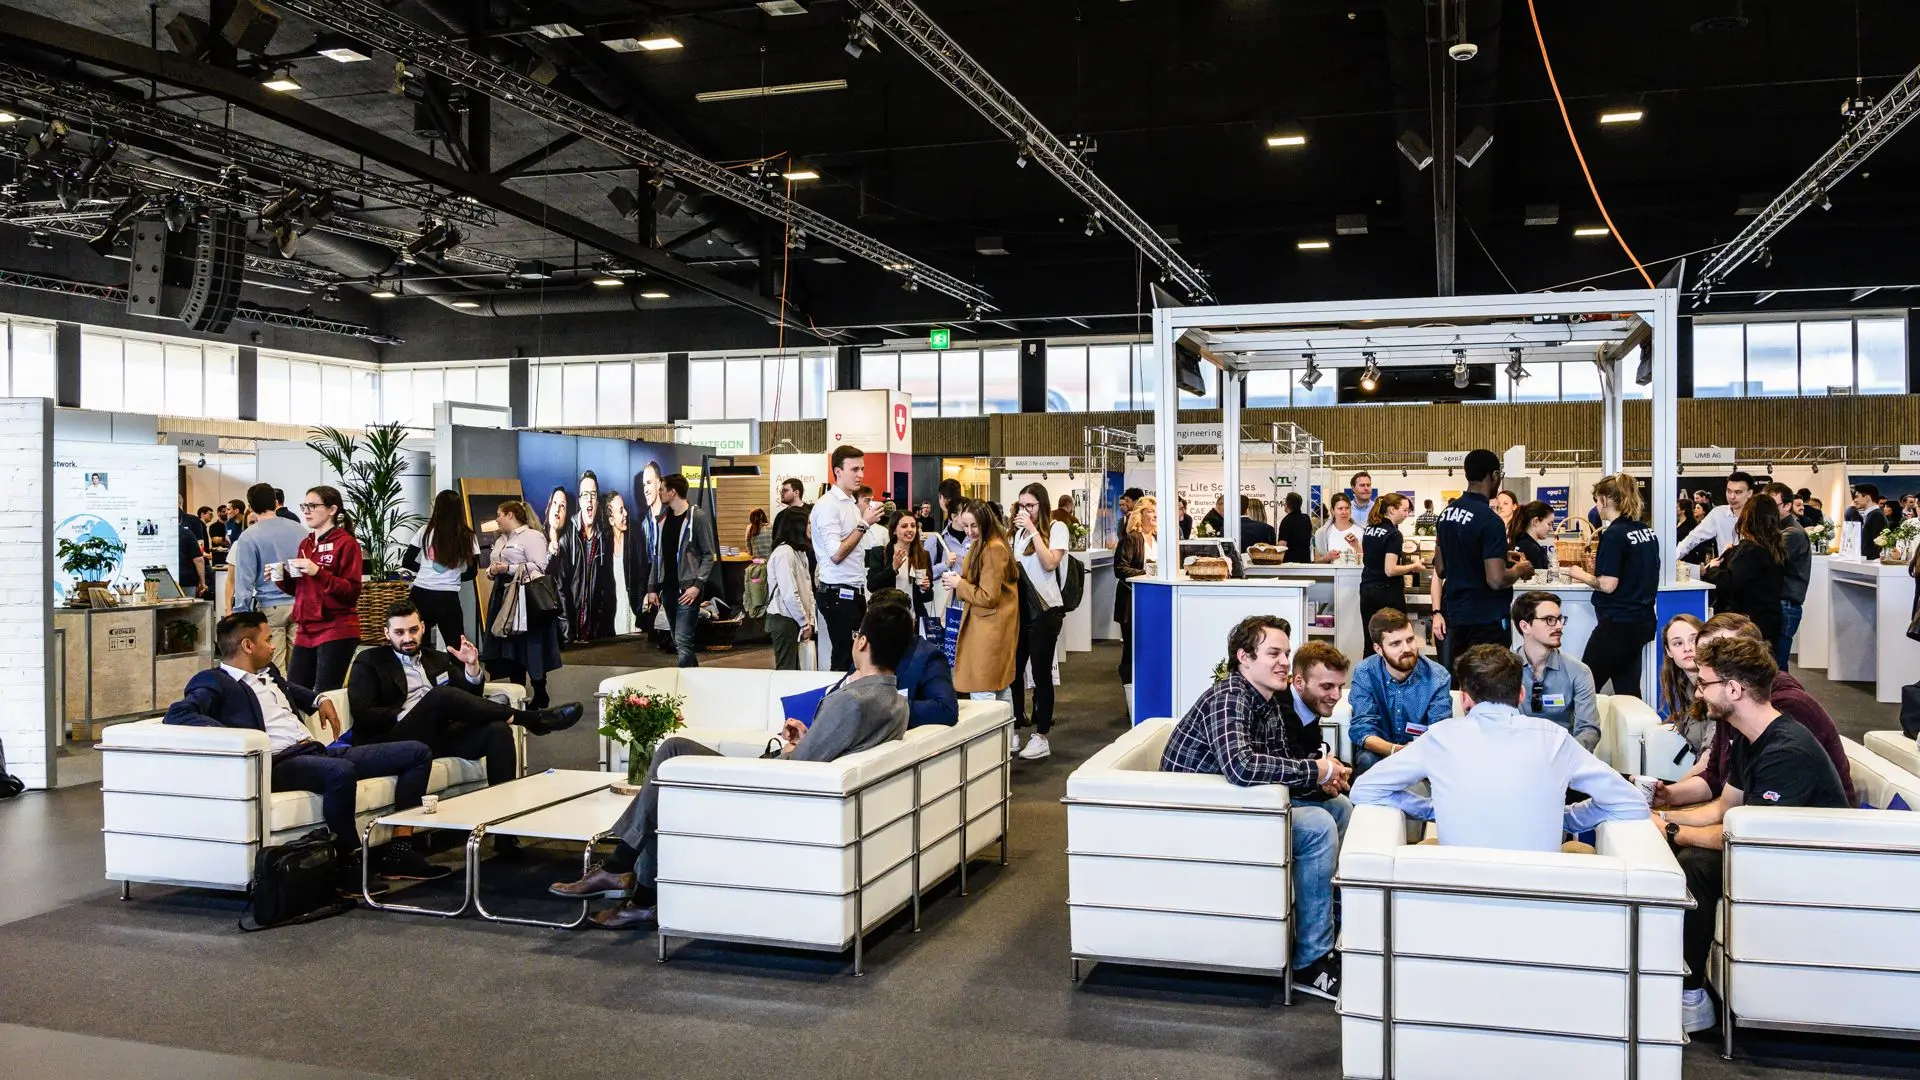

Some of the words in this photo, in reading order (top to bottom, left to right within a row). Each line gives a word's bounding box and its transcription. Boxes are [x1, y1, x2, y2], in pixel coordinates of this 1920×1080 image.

[1176, 429, 1222, 438] ngineering
[181, 439, 194, 447] IMT
[693, 440, 744, 449] YNTEGON
[52, 460, 78, 468] etwork.
[1190, 483, 1209, 492] Life
[1210, 483, 1256, 492] Scces
[1439, 506, 1475, 526] STAFF
[1364, 526, 1388, 538] TAFF
[1626, 527, 1657, 545] STAFF
